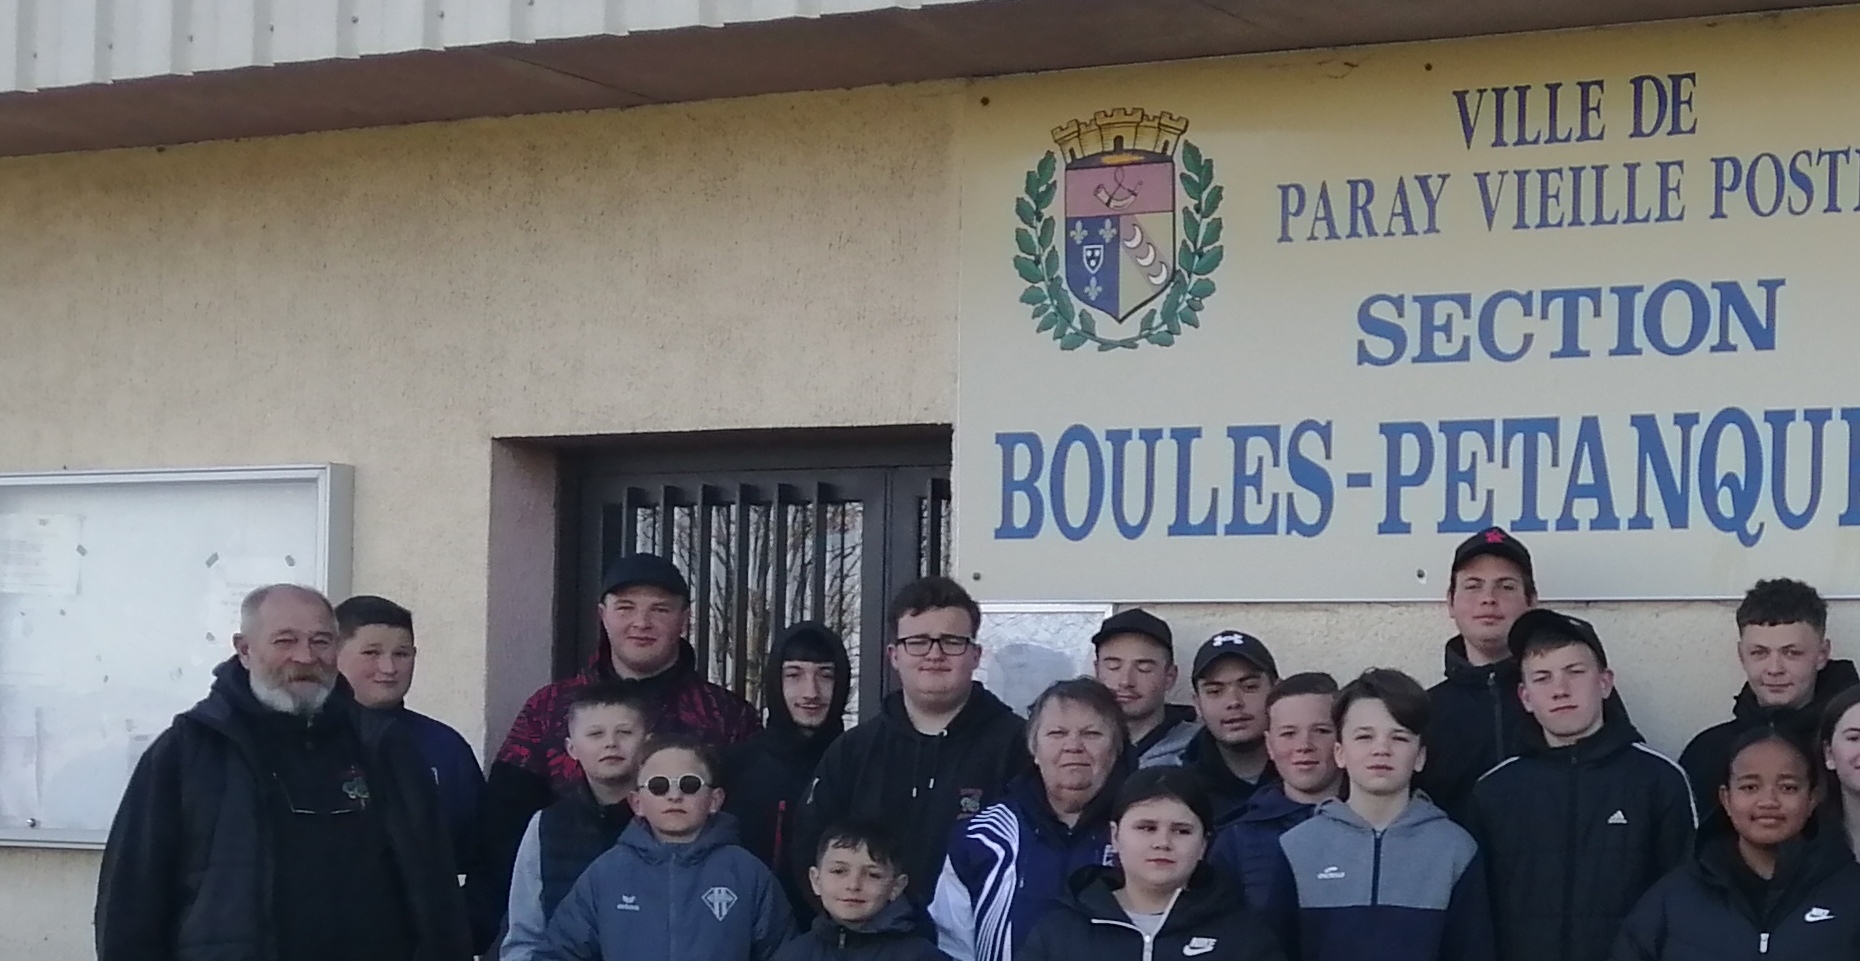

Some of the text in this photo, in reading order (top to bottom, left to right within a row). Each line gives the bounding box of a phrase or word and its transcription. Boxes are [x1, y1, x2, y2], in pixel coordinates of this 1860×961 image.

[1452, 71, 1698, 150] VILLE DE
[1277, 173, 1451, 244] PARAY
[1472, 159, 1686, 232] VIEILLE
[1356, 278, 1786, 367] SECTION
